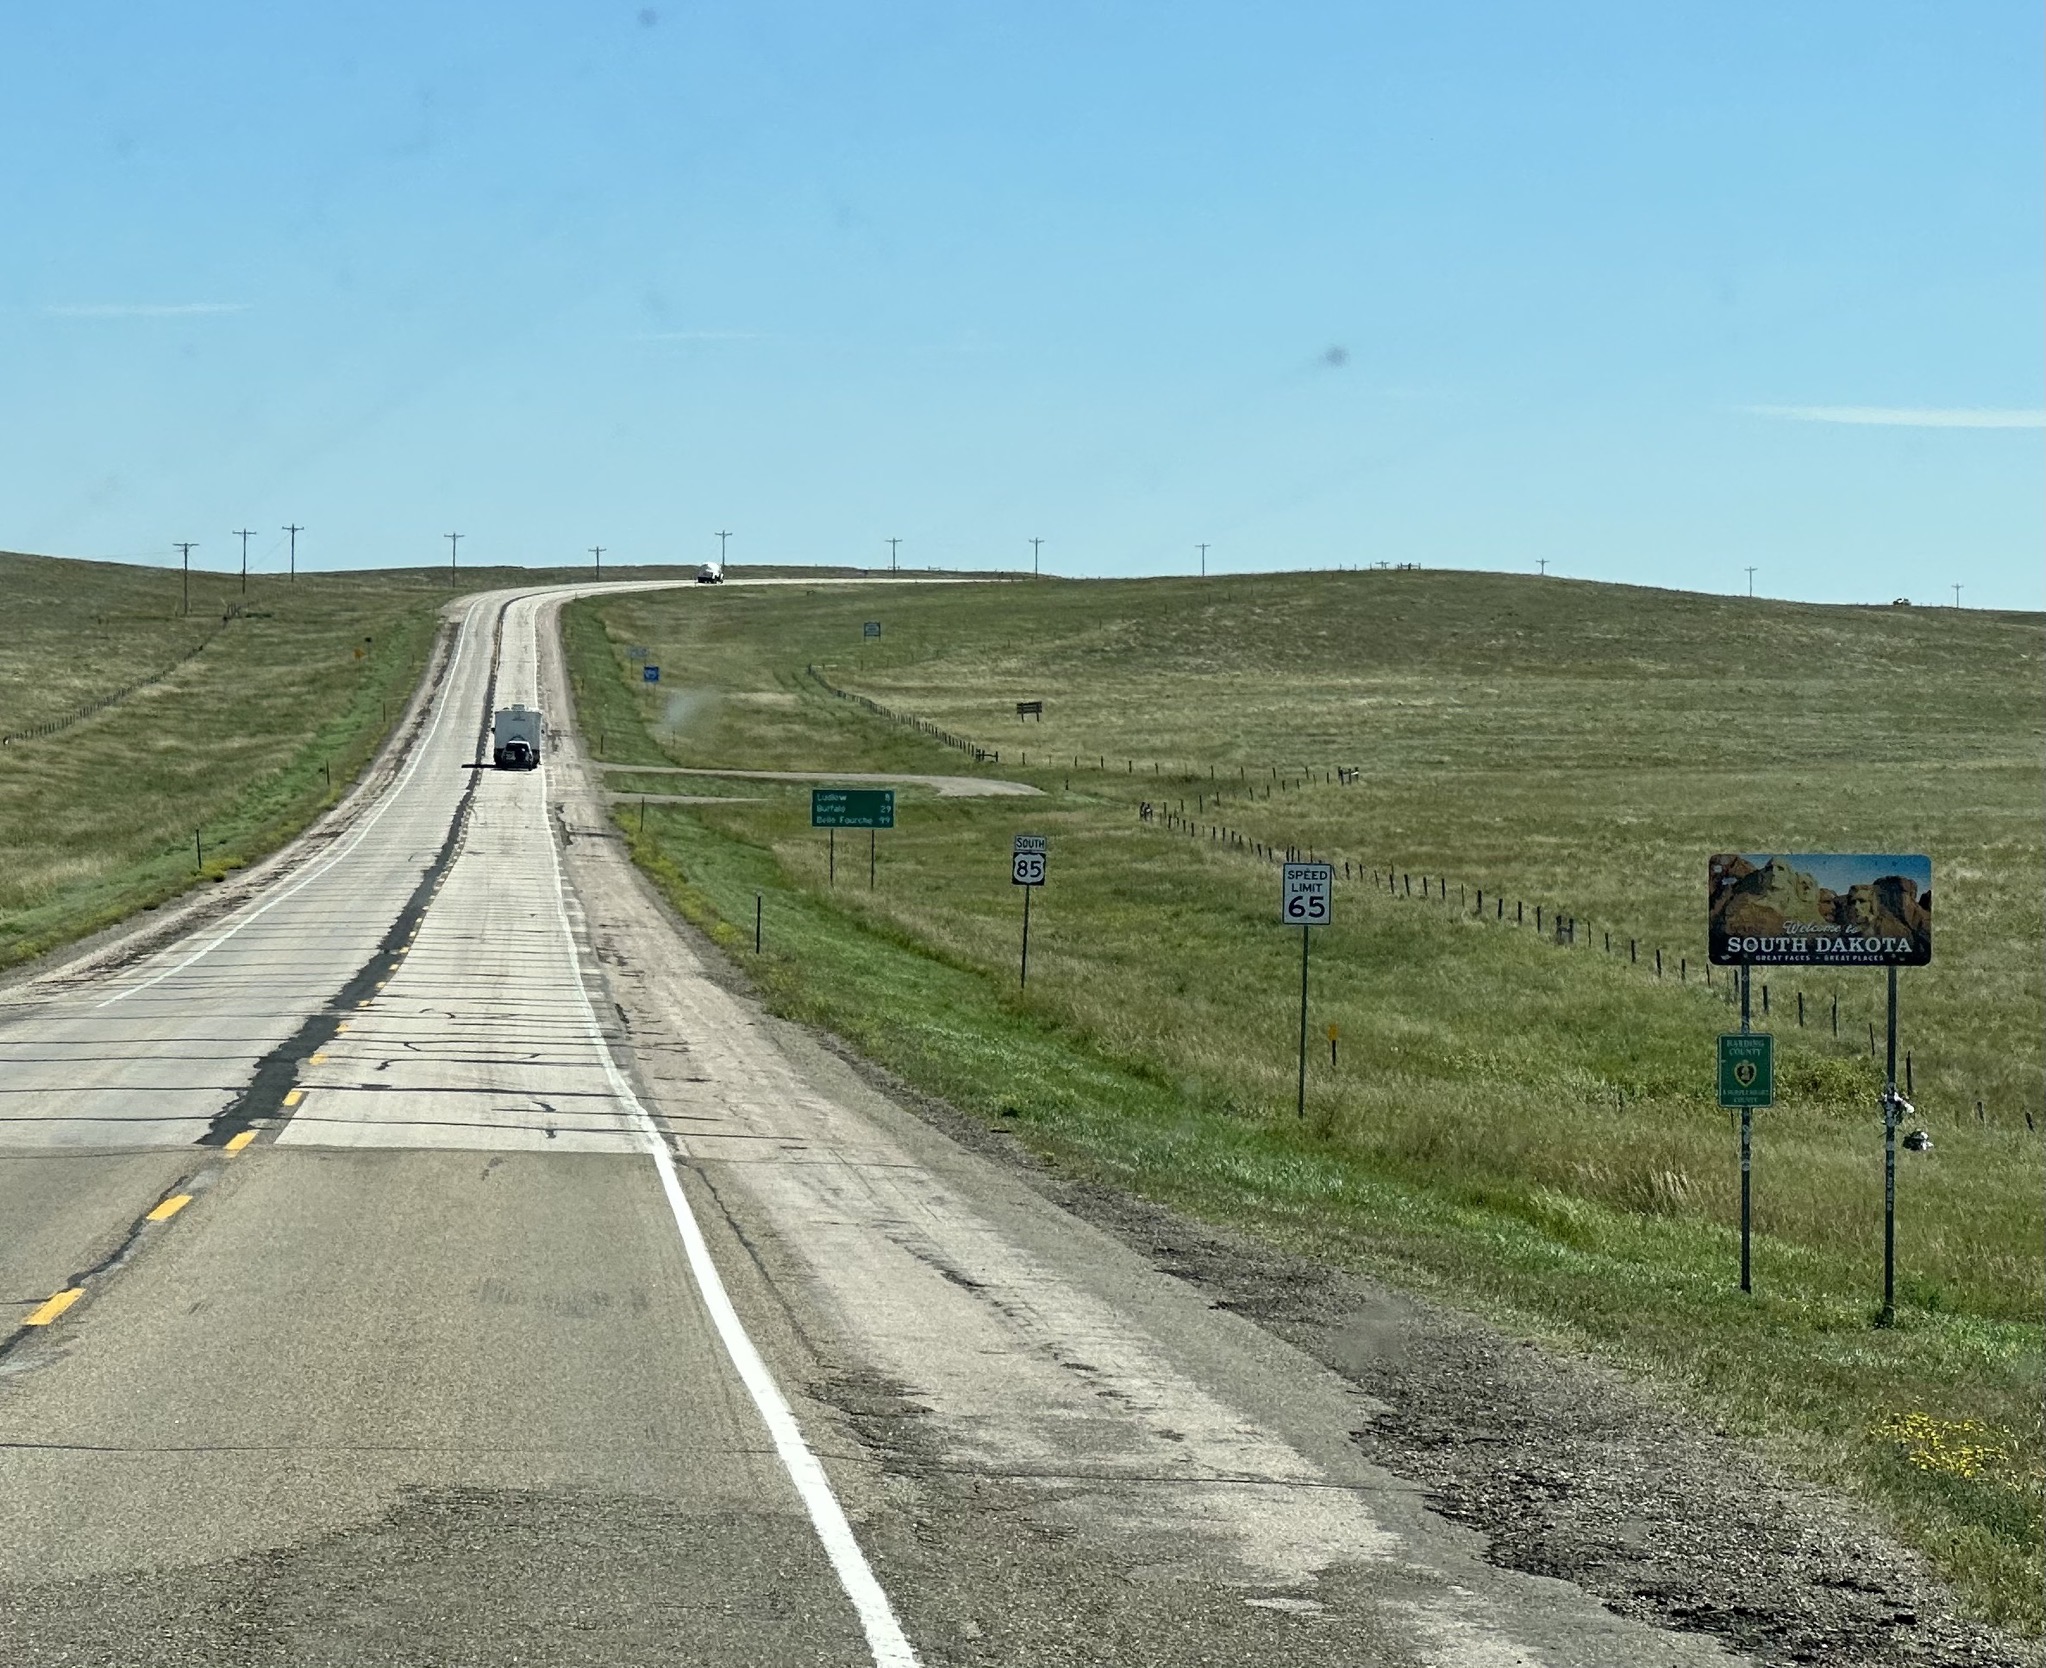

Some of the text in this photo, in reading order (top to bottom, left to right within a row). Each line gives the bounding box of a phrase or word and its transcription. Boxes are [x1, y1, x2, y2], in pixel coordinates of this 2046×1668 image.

[880, 805, 892, 814] 29
[879, 816, 891, 824] 99
[1016, 837, 1045, 848] SOUTH
[1016, 860, 1042, 878] 85
[1287, 870, 1328, 880] SPEED
[1291, 883, 1323, 892] LIMIT
[1288, 895, 1325, 918] 65
[1782, 920, 1860, 934] Welcome to
[1727, 936, 1913, 953] SOUTH DAKOTA
[1729, 1048, 1762, 1056] COUNTY
